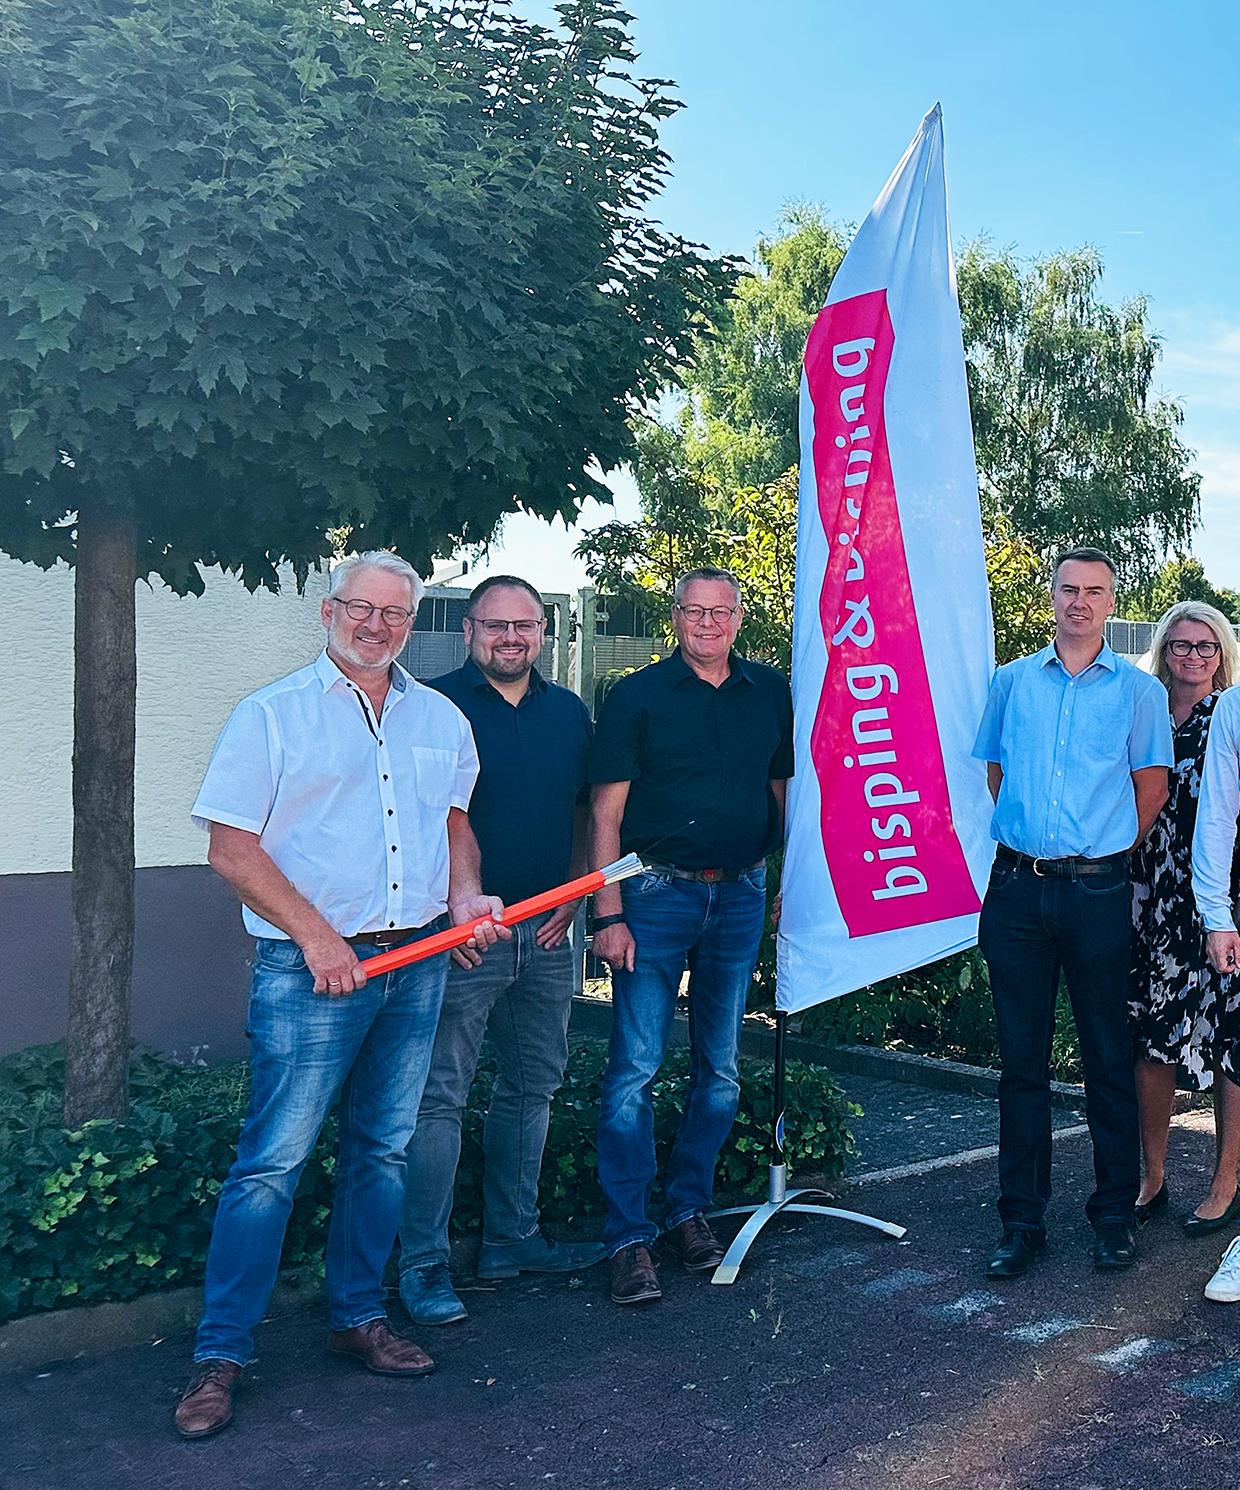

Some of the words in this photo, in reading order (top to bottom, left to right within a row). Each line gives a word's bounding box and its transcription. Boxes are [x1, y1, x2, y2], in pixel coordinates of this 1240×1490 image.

[832, 336, 876, 583] bping
[831, 594, 876, 649] &
[842, 662, 928, 901] bisping
